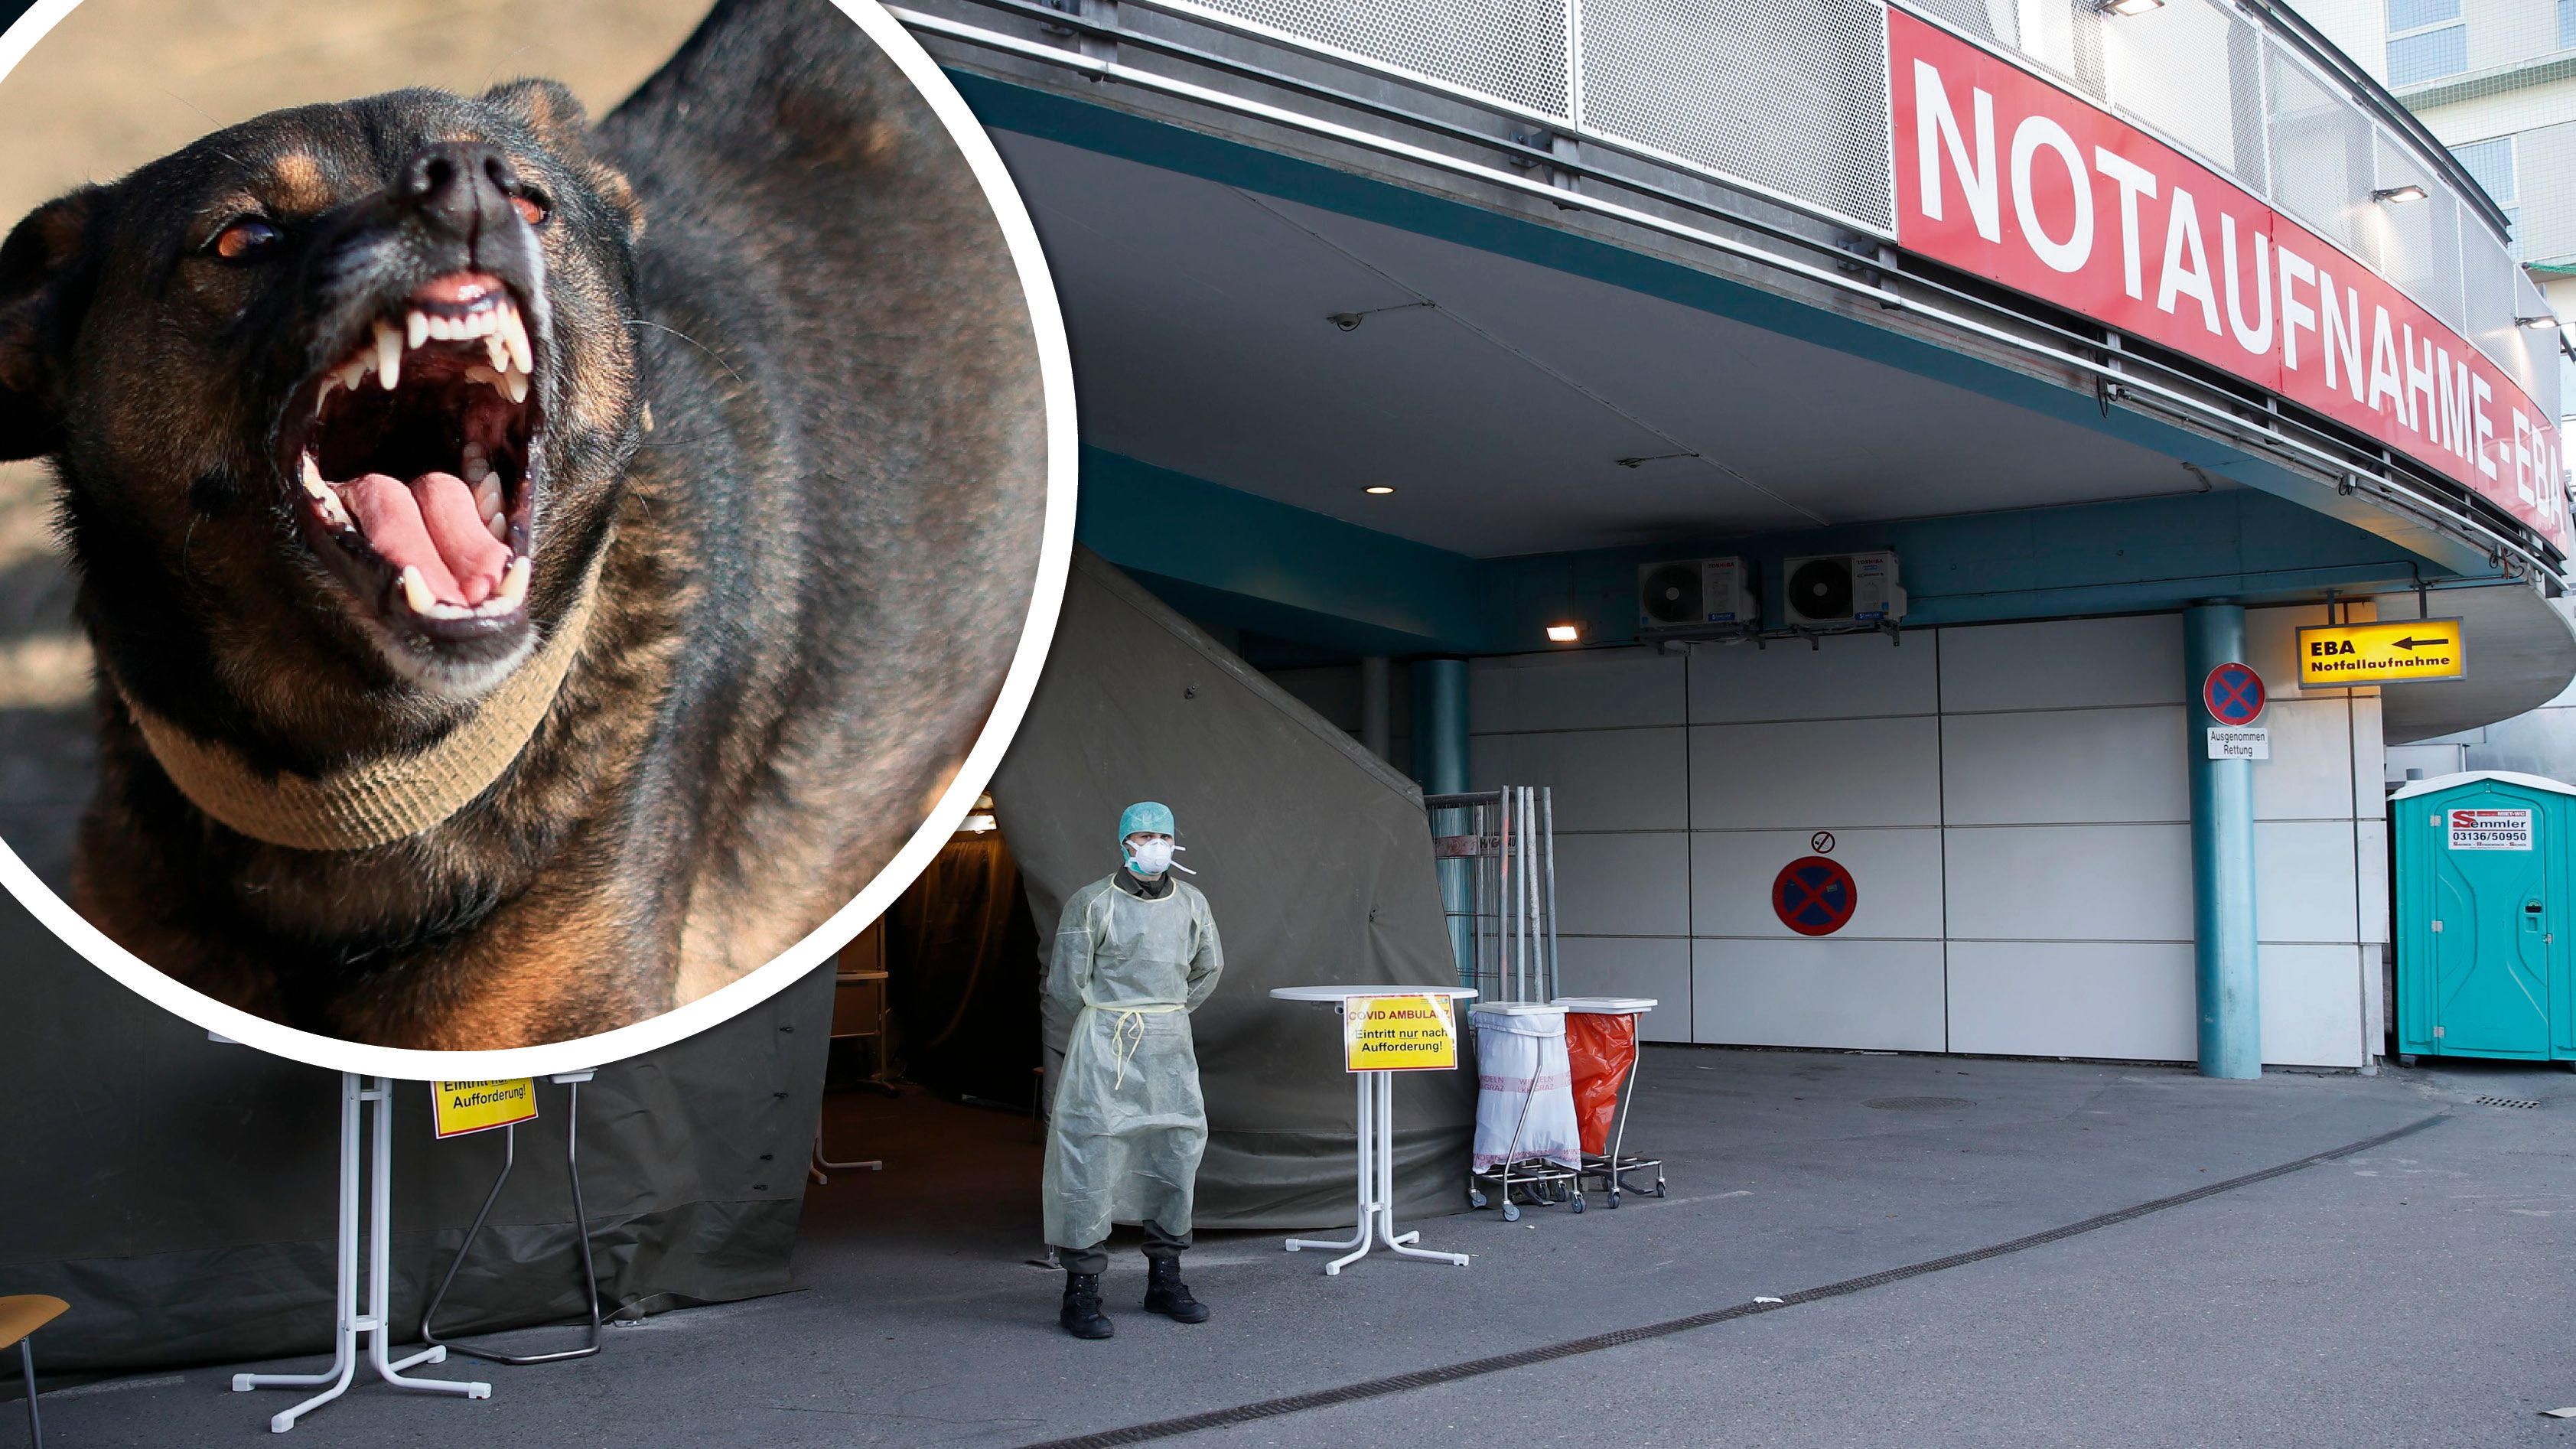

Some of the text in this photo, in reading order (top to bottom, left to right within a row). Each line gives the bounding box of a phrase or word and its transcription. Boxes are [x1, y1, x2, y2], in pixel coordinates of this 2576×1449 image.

[2311, 640, 2356, 656] EBA
[2311, 656, 2451, 672] Notfallaufnahme
[2210, 731, 2265, 744] Ausgenommen
[2223, 744, 2253, 757] Rettung
[2452, 810, 2526, 828] Semmler
[2453, 832, 2527, 841] 03136/50950
[1349, 1010, 1386, 1021] COVID
[1355, 1027, 1448, 1039] Eintritt nur nach
[1362, 1041, 1443, 1053] Aufforderung!
[452, 1084, 526, 1109] Aufforderung!
